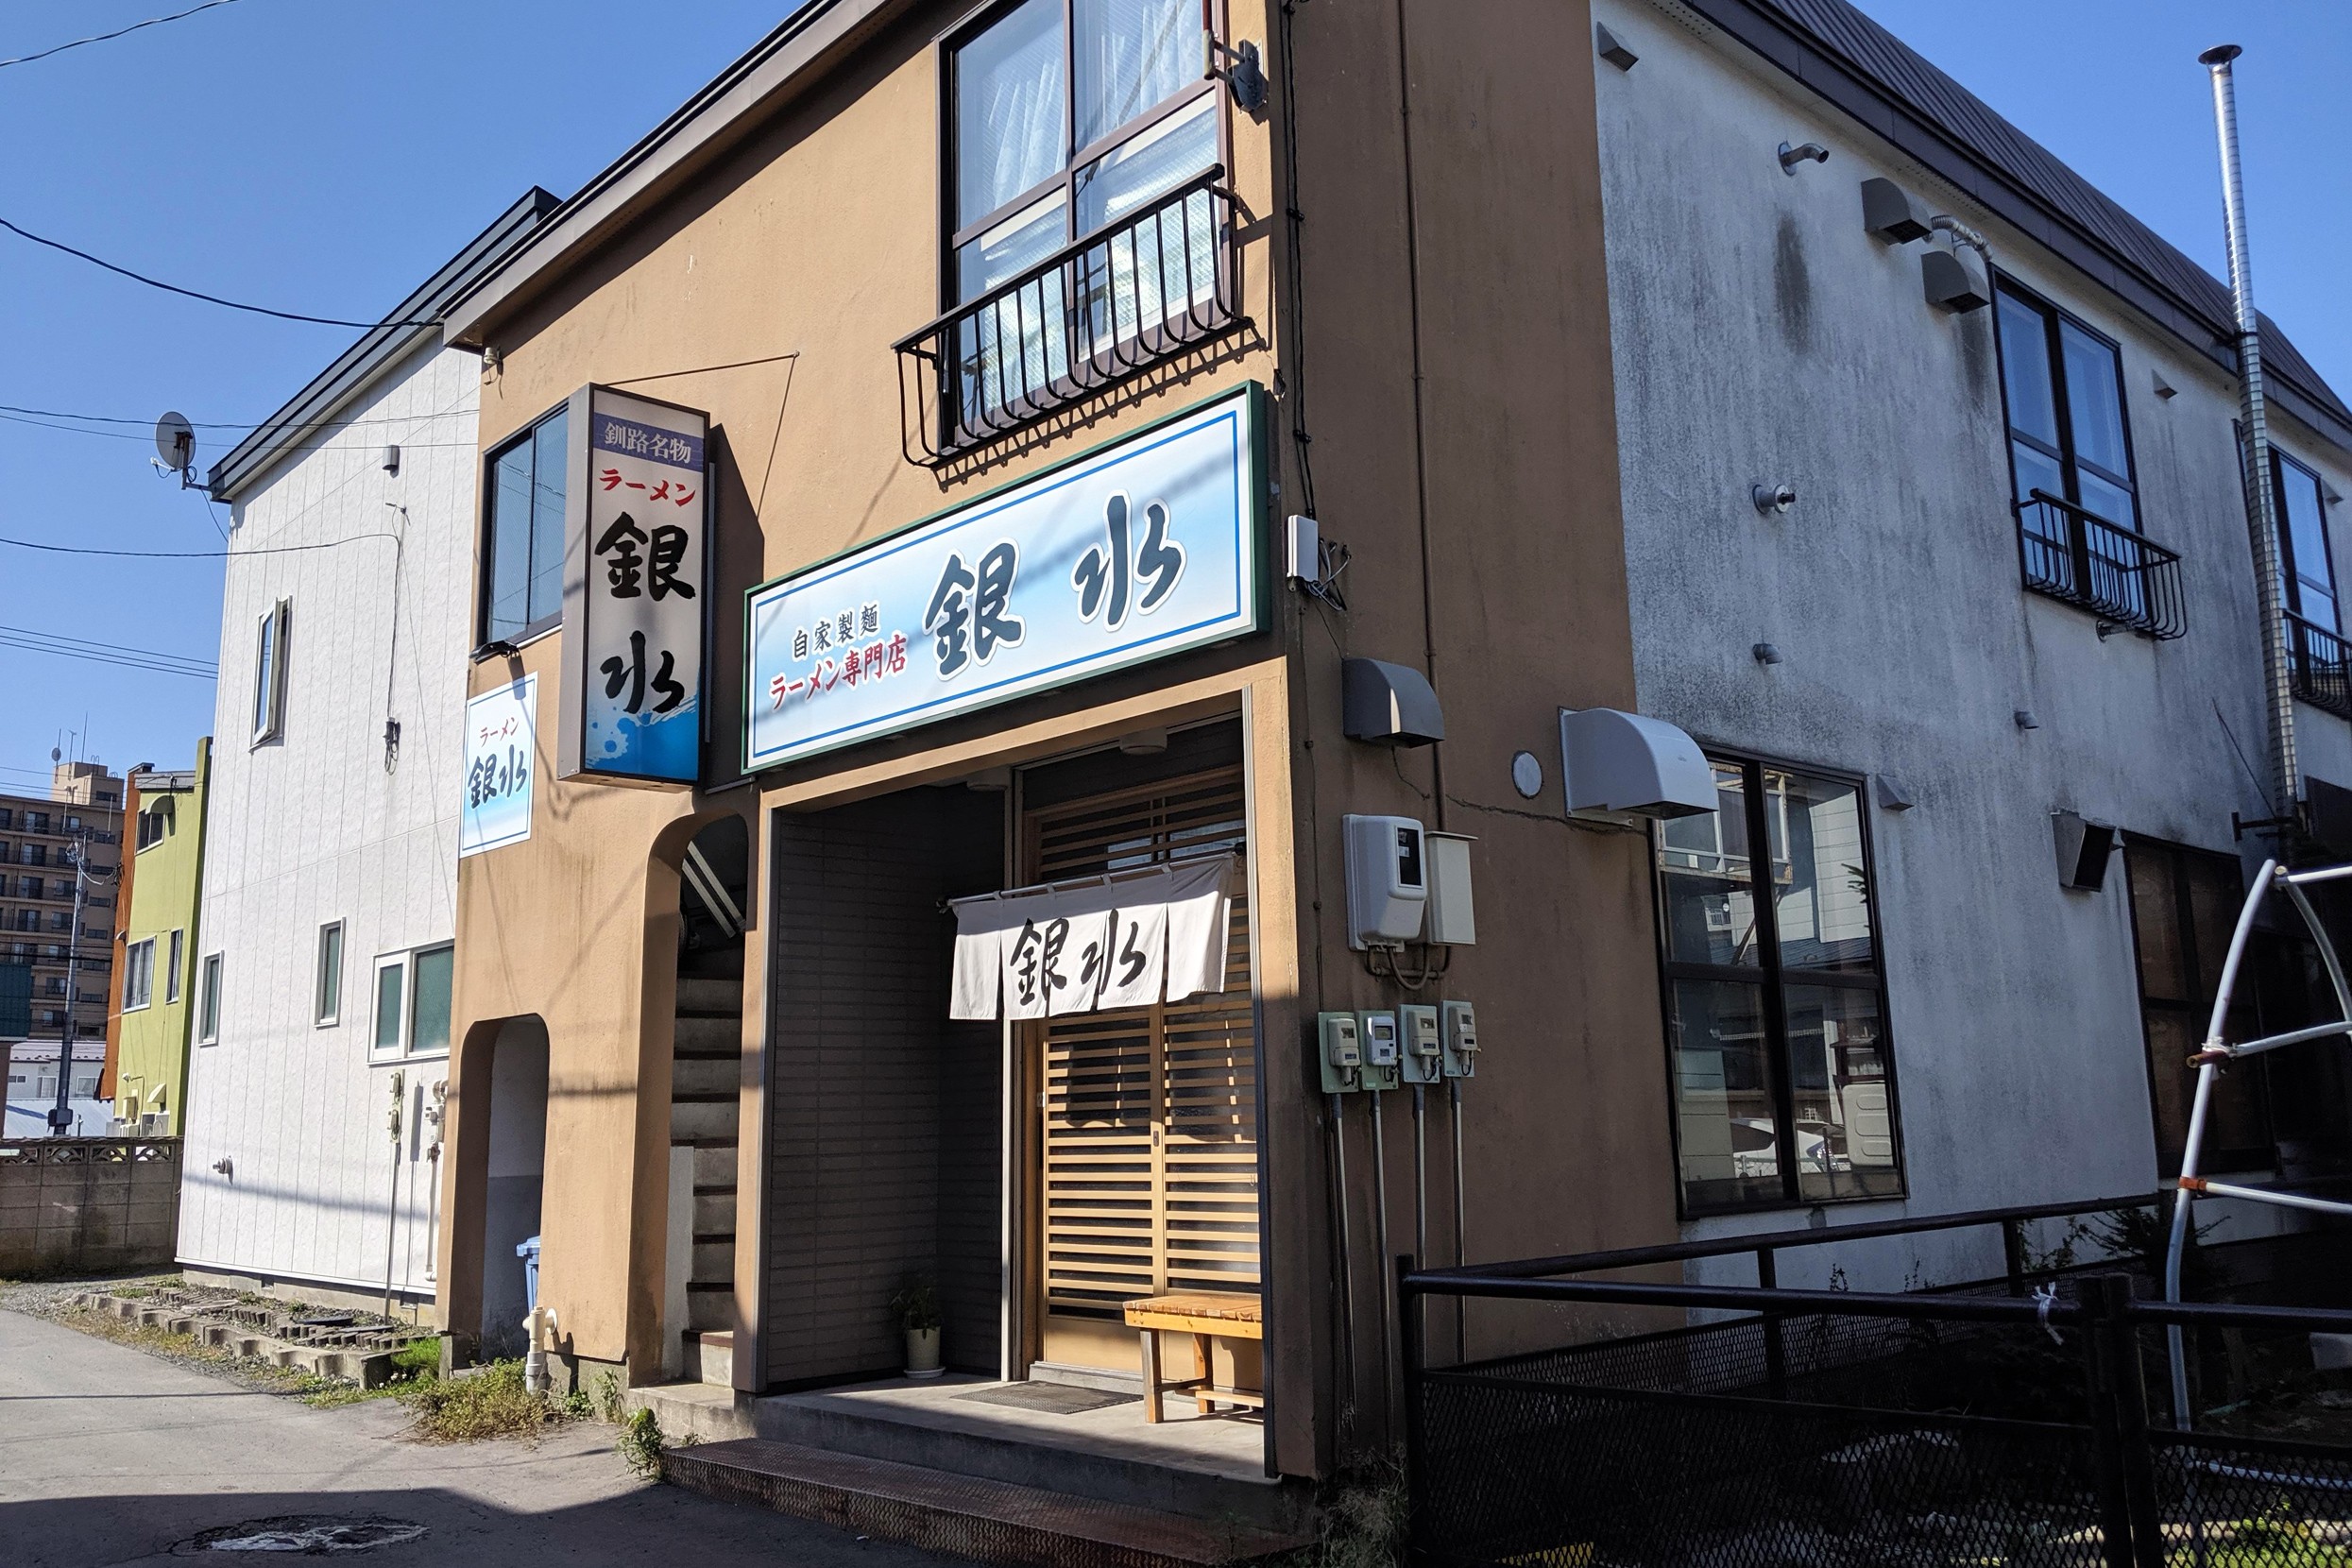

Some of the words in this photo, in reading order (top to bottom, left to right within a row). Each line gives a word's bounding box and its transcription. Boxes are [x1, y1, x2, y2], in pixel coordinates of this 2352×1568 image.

[605, 421, 691, 463] 釧路名物
[600, 469, 696, 507] ラーメン
[594, 511, 696, 714] 銀水
[926, 495, 1183, 675] 銀水
[771, 634, 907, 710] ラーメン専門店
[480, 717, 520, 748] ラーメン
[468, 744, 527, 810] 銀水
[1010, 908, 1147, 1006] 銀水
